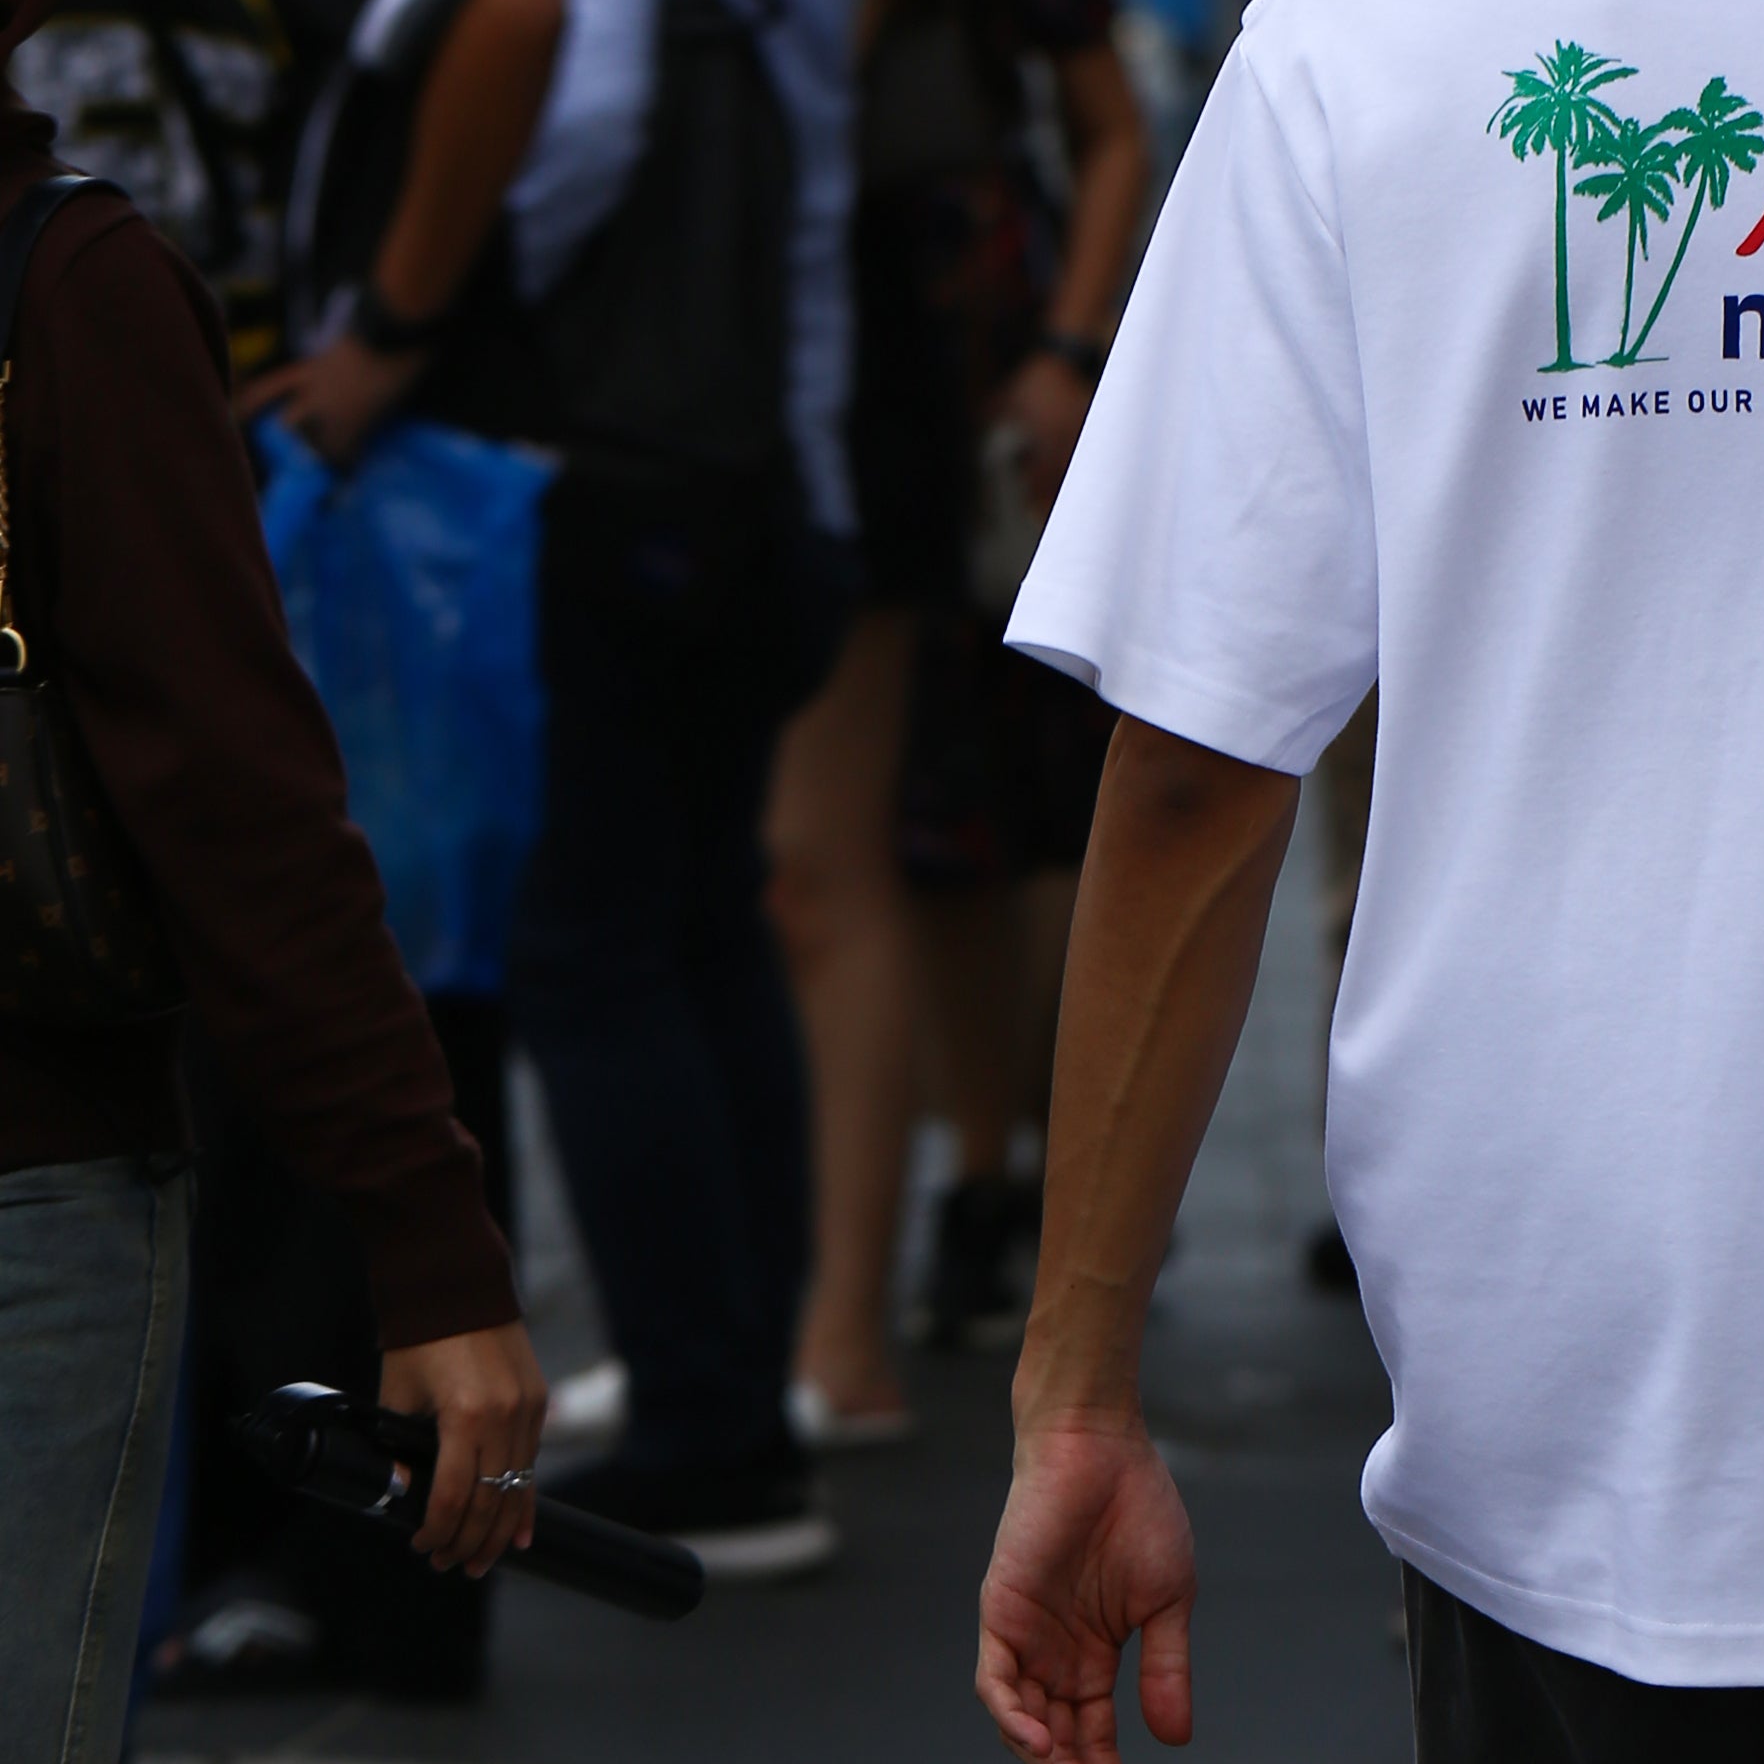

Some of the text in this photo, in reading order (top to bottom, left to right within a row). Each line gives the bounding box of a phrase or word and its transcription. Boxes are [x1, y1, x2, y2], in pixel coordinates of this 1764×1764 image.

[1521, 395, 1567, 423] WE
[1582, 390, 1670, 419] MAKE
[1687, 388, 1753, 414] OUR
